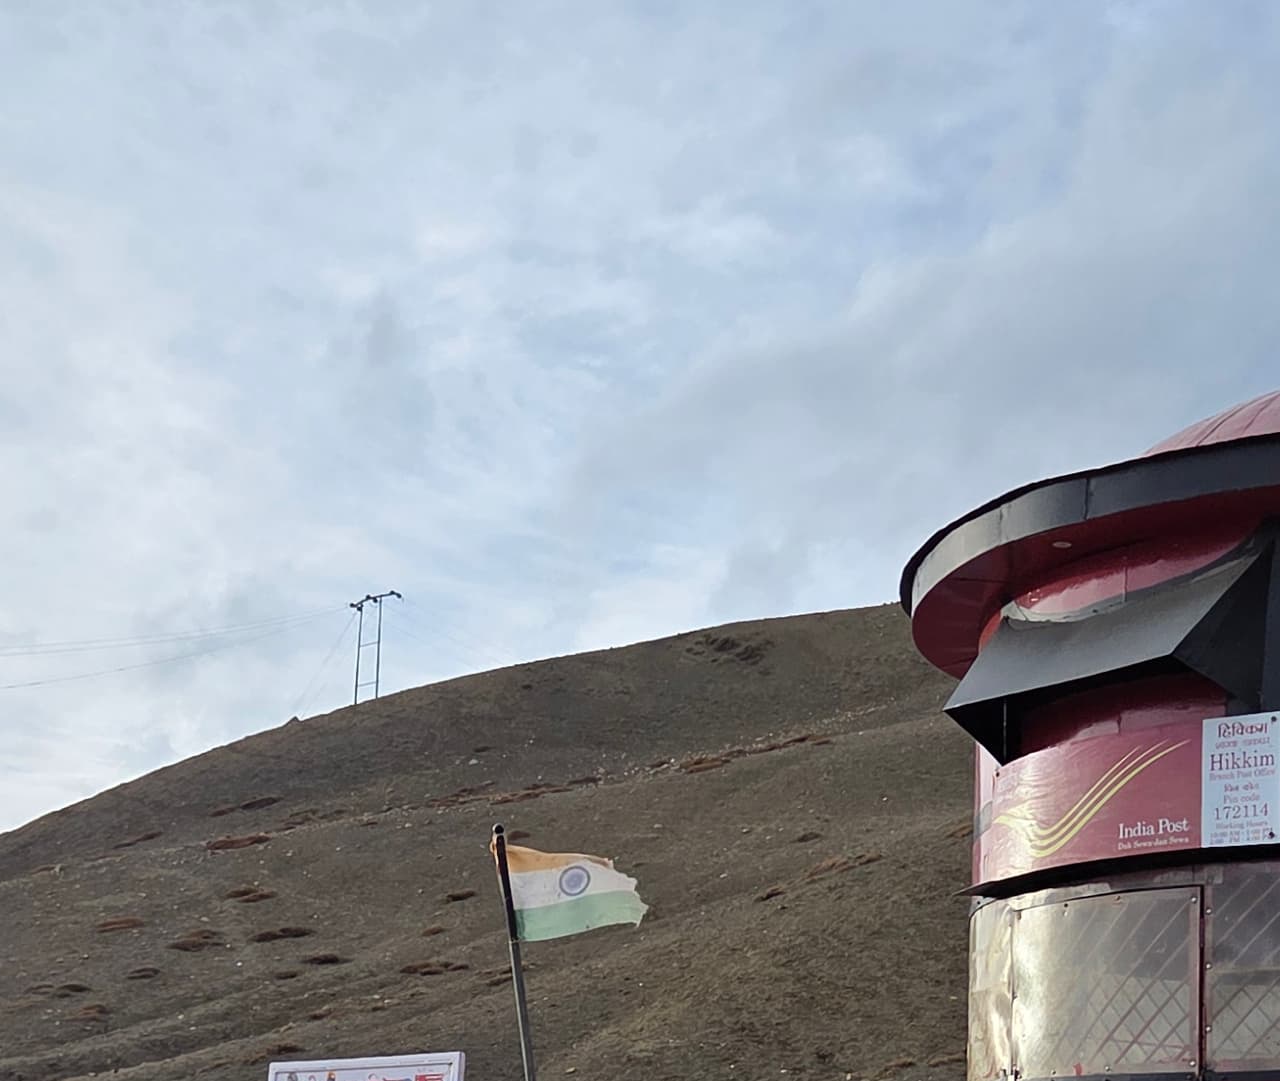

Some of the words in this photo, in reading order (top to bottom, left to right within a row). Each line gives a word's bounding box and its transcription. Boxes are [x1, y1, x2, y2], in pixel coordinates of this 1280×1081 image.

[1210, 750, 1275, 771] Hikkim
[1254, 767, 1276, 777] Office
[1215, 803, 1268, 820] 172114
[1118, 821, 1155, 839] India
[1158, 818, 1190, 834] Post
[1168, 836, 1190, 844] Sewa
